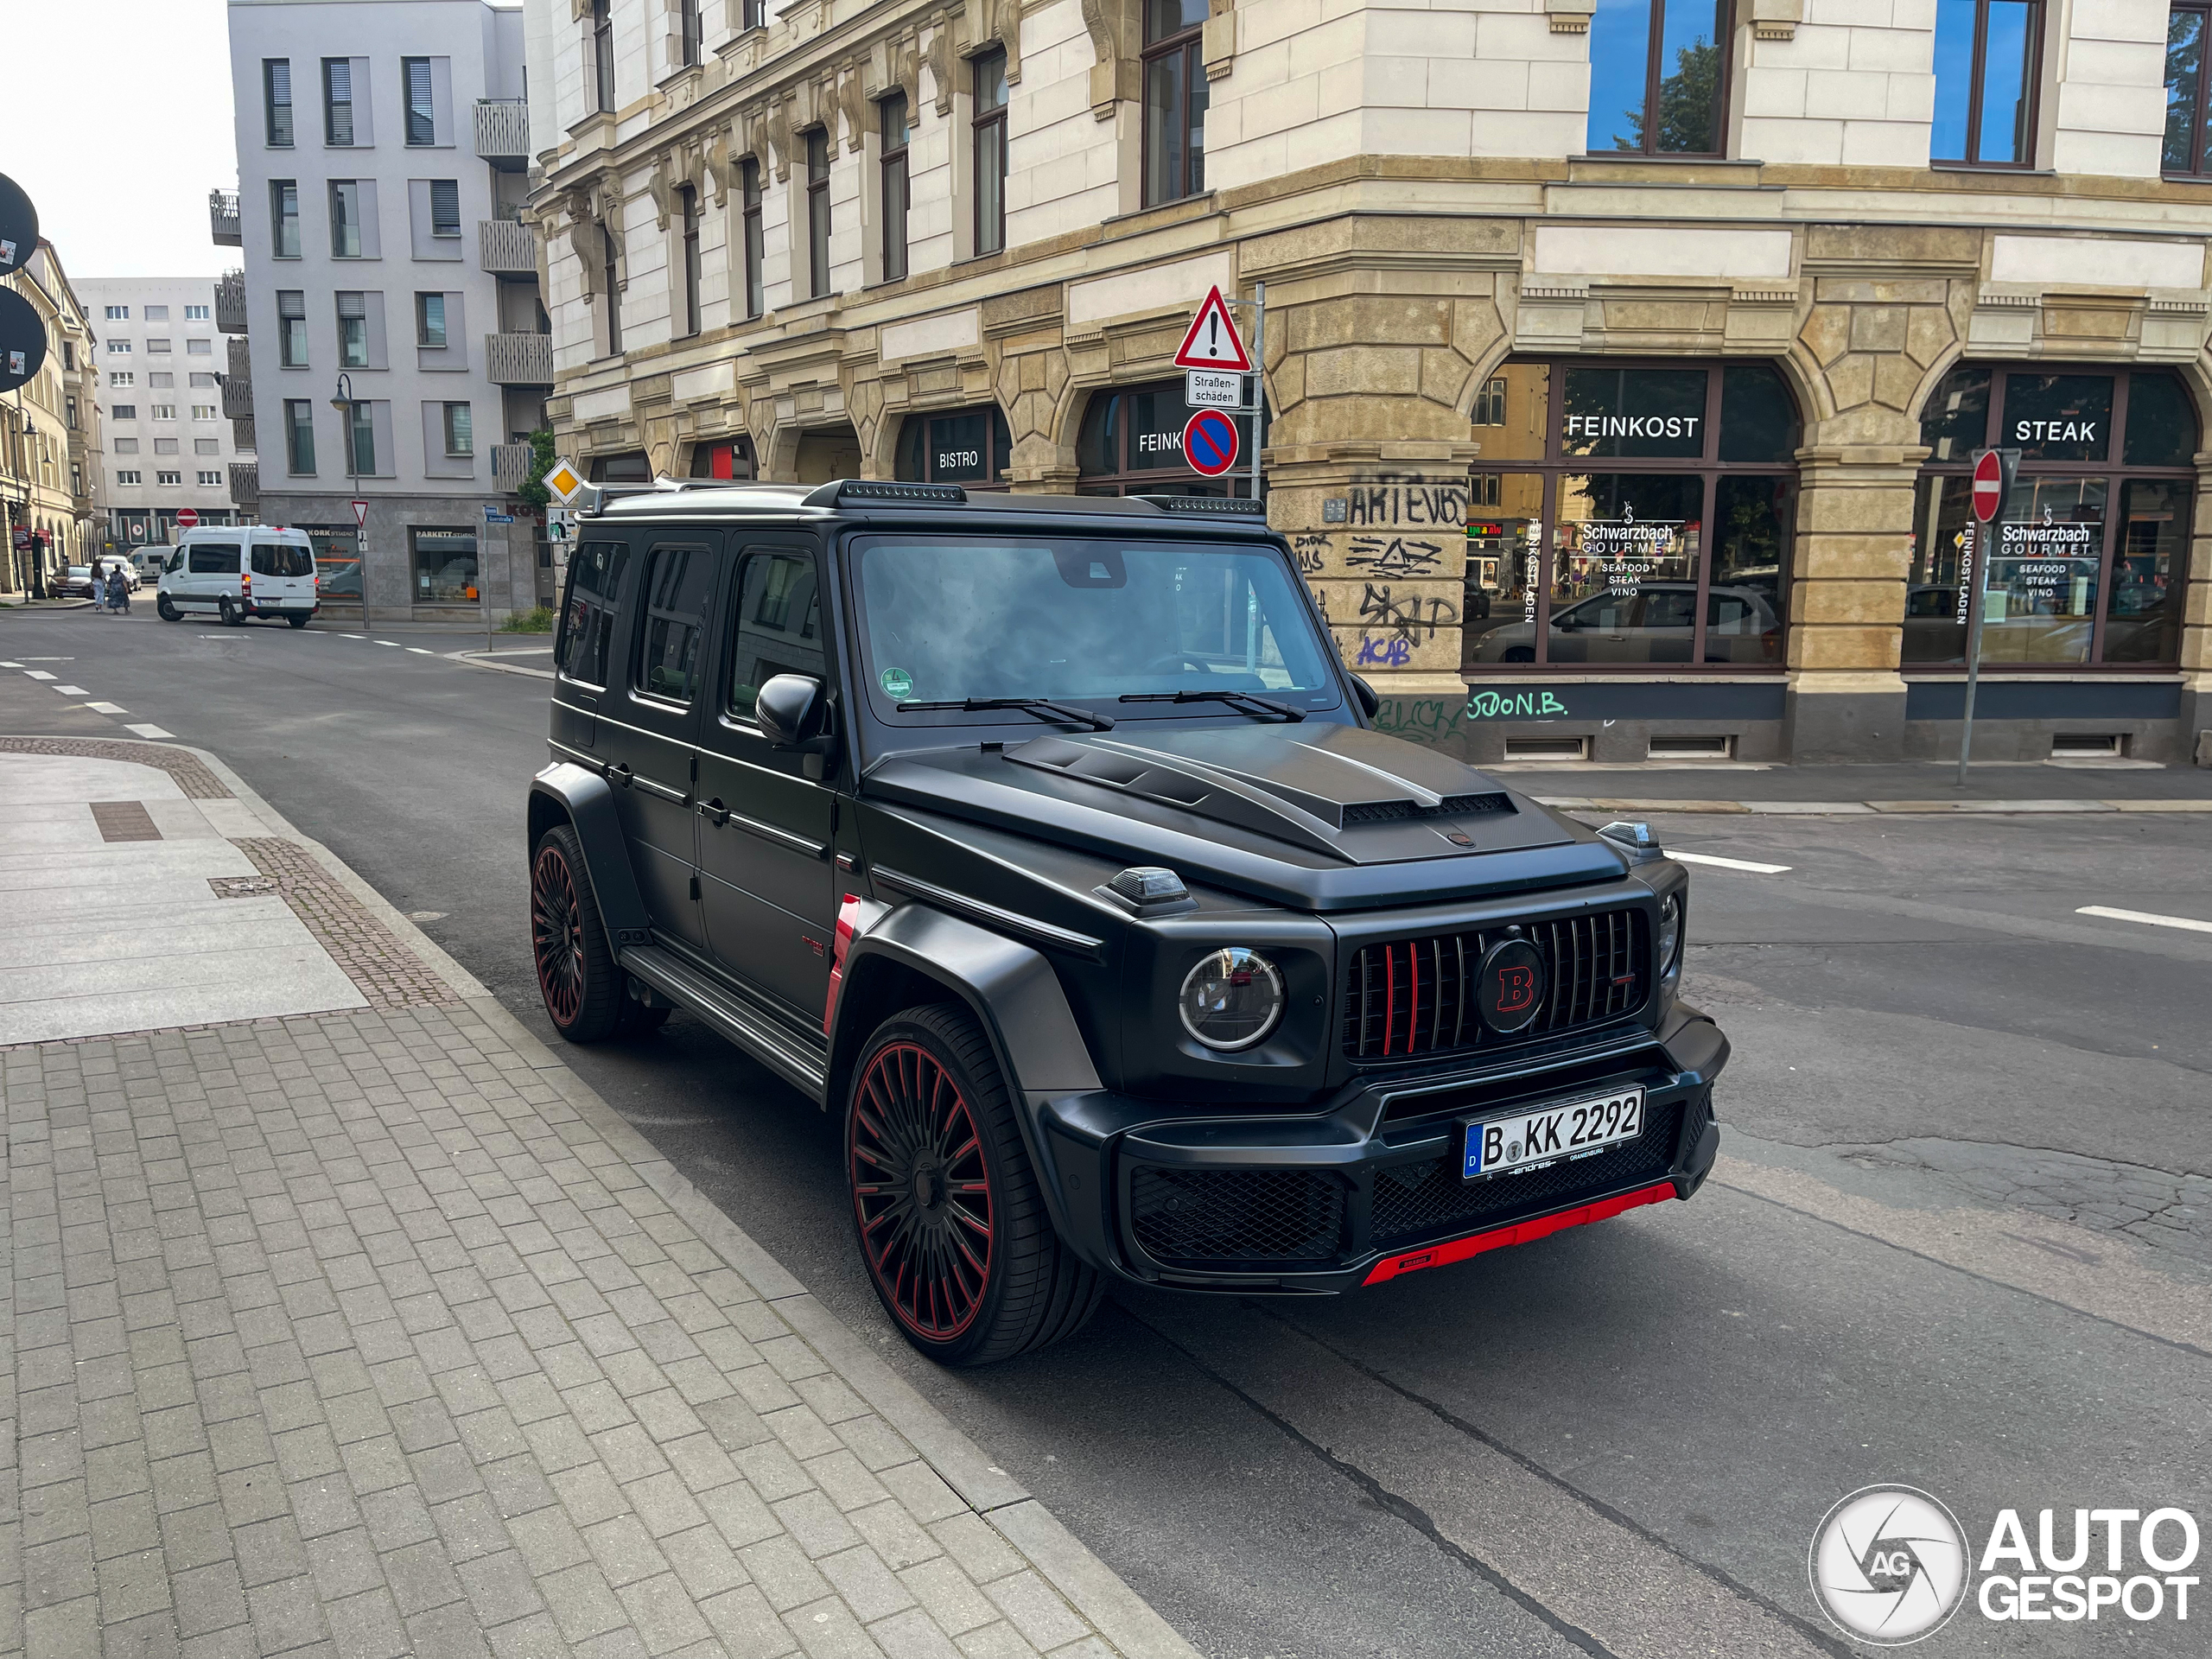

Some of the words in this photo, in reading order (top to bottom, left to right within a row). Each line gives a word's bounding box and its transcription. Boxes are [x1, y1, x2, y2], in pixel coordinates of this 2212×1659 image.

[1195, 376, 1235, 388] Straßen-
[1196, 391, 1233, 403] schäden
[1568, 416, 1699, 438] FEINKOST
[2015, 420, 2096, 442] STEAK
[1140, 432, 1181, 452] FEINK
[938, 450, 978, 468] BISTRO
[1582, 524, 1673, 540] Schwarzbach
[2002, 526, 2090, 543] Schwarzbach
[1581, 542, 1675, 554] GOURMET
[2001, 543, 2091, 556] GOURMET
[1601, 563, 1650, 573] SEAFOOD
[1956, 520, 1975, 626] FEINKOST-LADEN
[2018, 564, 2067, 575] SEAFOOD
[1608, 575, 1642, 585] STEAK
[2025, 576, 2057, 586] STEAK
[1611, 588, 1638, 597] VINO
[2027, 588, 2053, 598] VINO
[1497, 966, 1534, 1013] B
[1484, 1126, 1503, 1166] B
[1524, 1112, 1565, 1157] KK
[1569, 1096, 1638, 1147] 2292
[1469, 1155, 1476, 1166] D
[1569, 1147, 1605, 1161] ORANIENBURG
